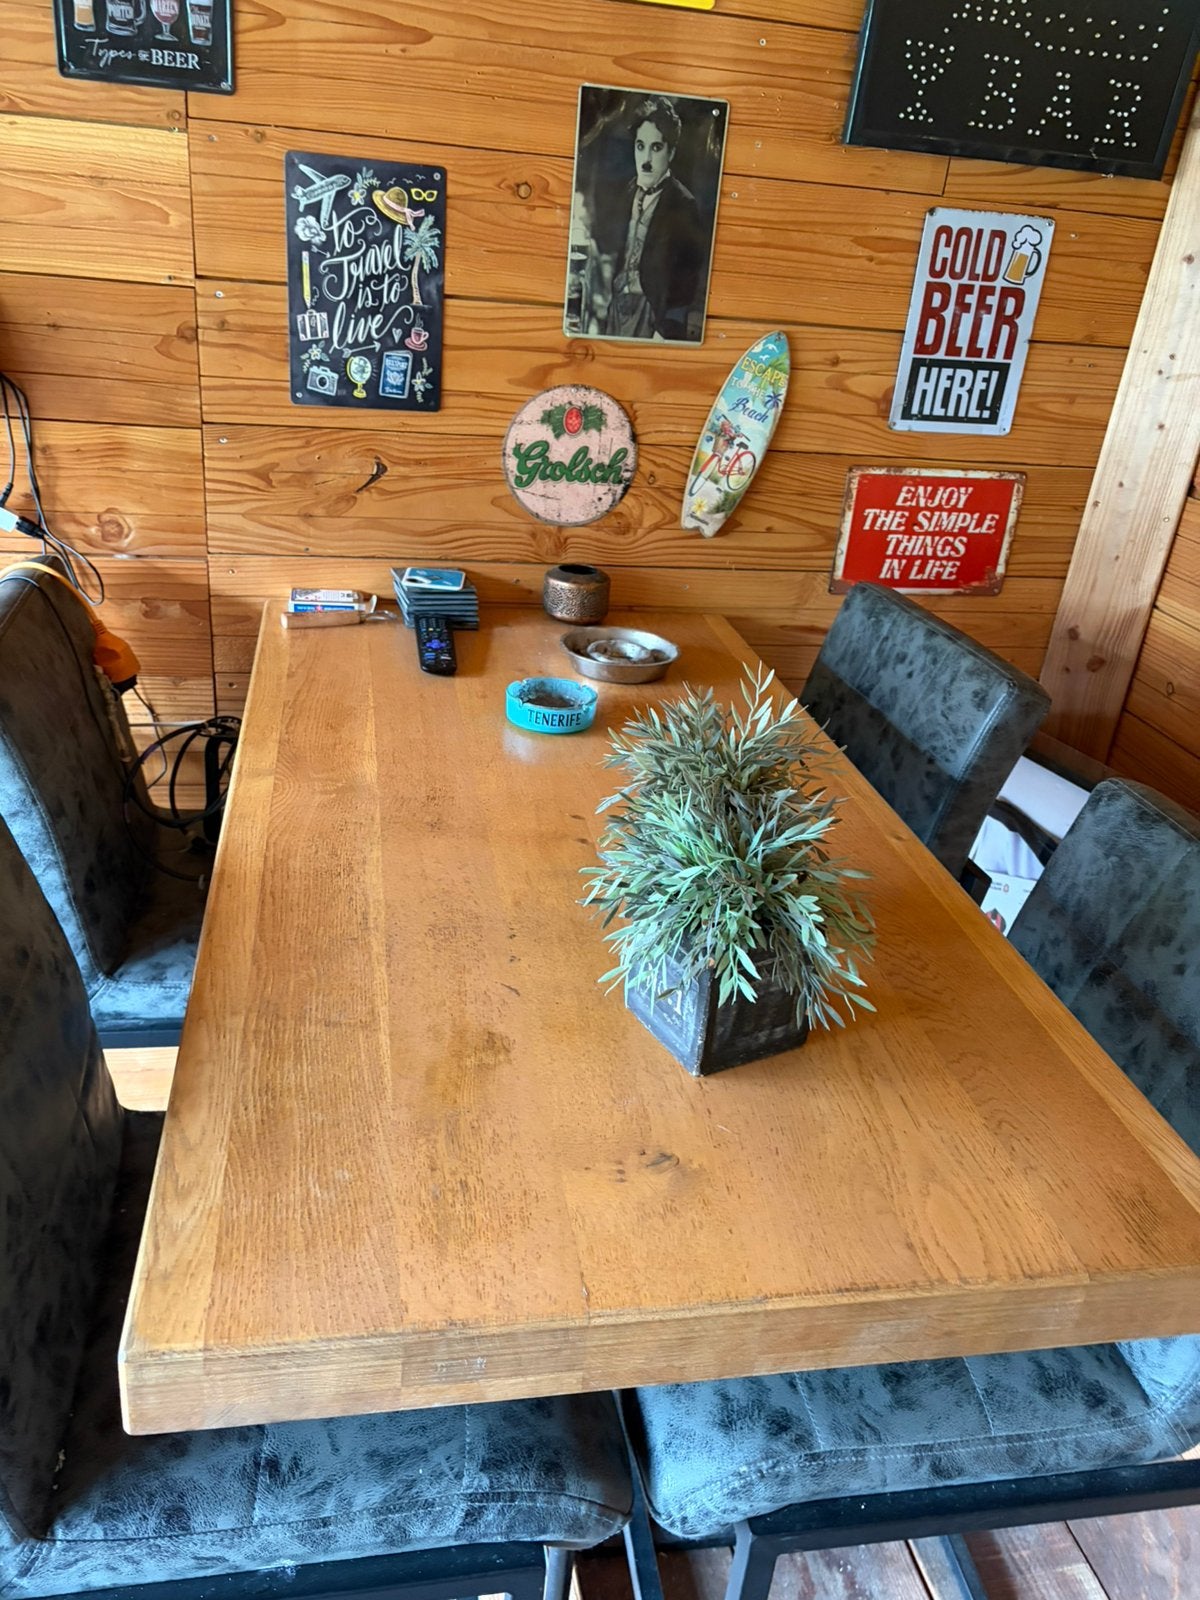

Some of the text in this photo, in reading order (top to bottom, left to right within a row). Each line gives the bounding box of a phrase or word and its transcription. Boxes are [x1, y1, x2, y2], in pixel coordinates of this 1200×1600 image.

[84, 38, 132, 68] Types
[150, 48, 201, 70] BEER
[967, 52, 1143, 148] BAR
[323, 206, 383, 257] to
[319, 224, 411, 302] Travel
[928, 224, 1008, 283] COLD
[354, 274, 409, 313] is to
[328, 301, 414, 354] live
[912, 281, 1026, 361] BEER
[740, 356, 789, 388] ESCAPE
[728, 397, 769, 424] Beach
[910, 366, 1000, 419] HERE!
[512, 440, 629, 488] Grolsch
[895, 485, 973, 509] ENJOY
[863, 508, 999, 534] THE SIMPLE
[885, 534, 968, 558] THINGS
[879, 558, 961, 580] IN LIFE
[527, 709, 582, 727] TENERIFE
